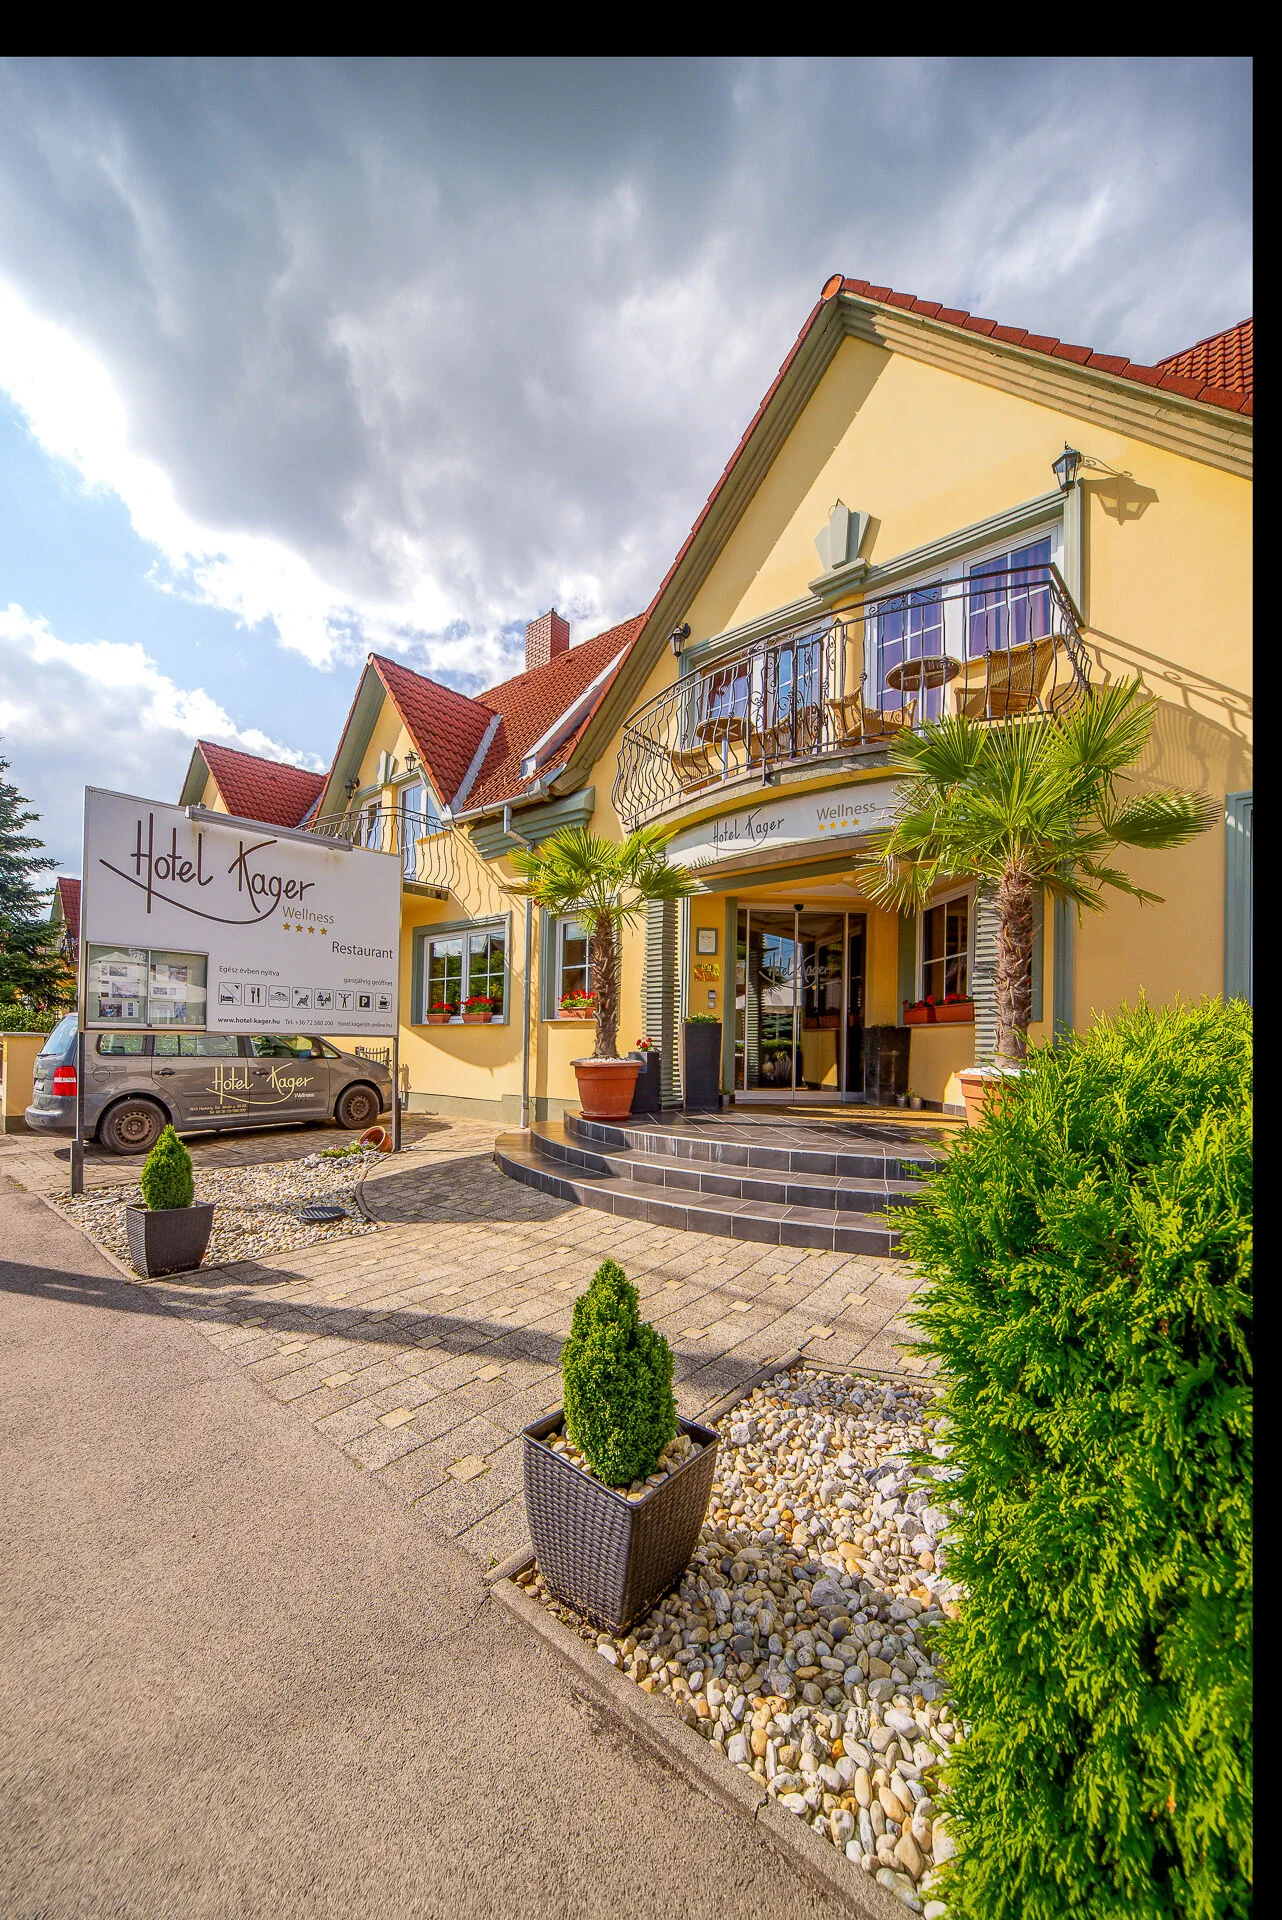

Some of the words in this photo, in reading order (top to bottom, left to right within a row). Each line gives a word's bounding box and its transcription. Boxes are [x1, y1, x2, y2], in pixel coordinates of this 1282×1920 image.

[816, 802, 877, 821] Wellness
[712, 818, 741, 856] Hotel
[744, 808, 785, 843] Kager
[130, 812, 213, 914] Hotel
[228, 839, 315, 914] Kager
[282, 905, 335, 925] Wellness
[331, 941, 394, 960] Restaurant
[219, 965, 238, 974] Egész
[239, 967, 260, 975] évben
[260, 969, 280, 977] nyitva
[343, 977, 371, 986] ganzjährig
[371, 979, 393, 987] geöffnet
[217, 1017, 281, 1026] www.hotel-kager.hu
[211, 1063, 254, 1105] Hotel
[265, 1062, 315, 1096] Kager
